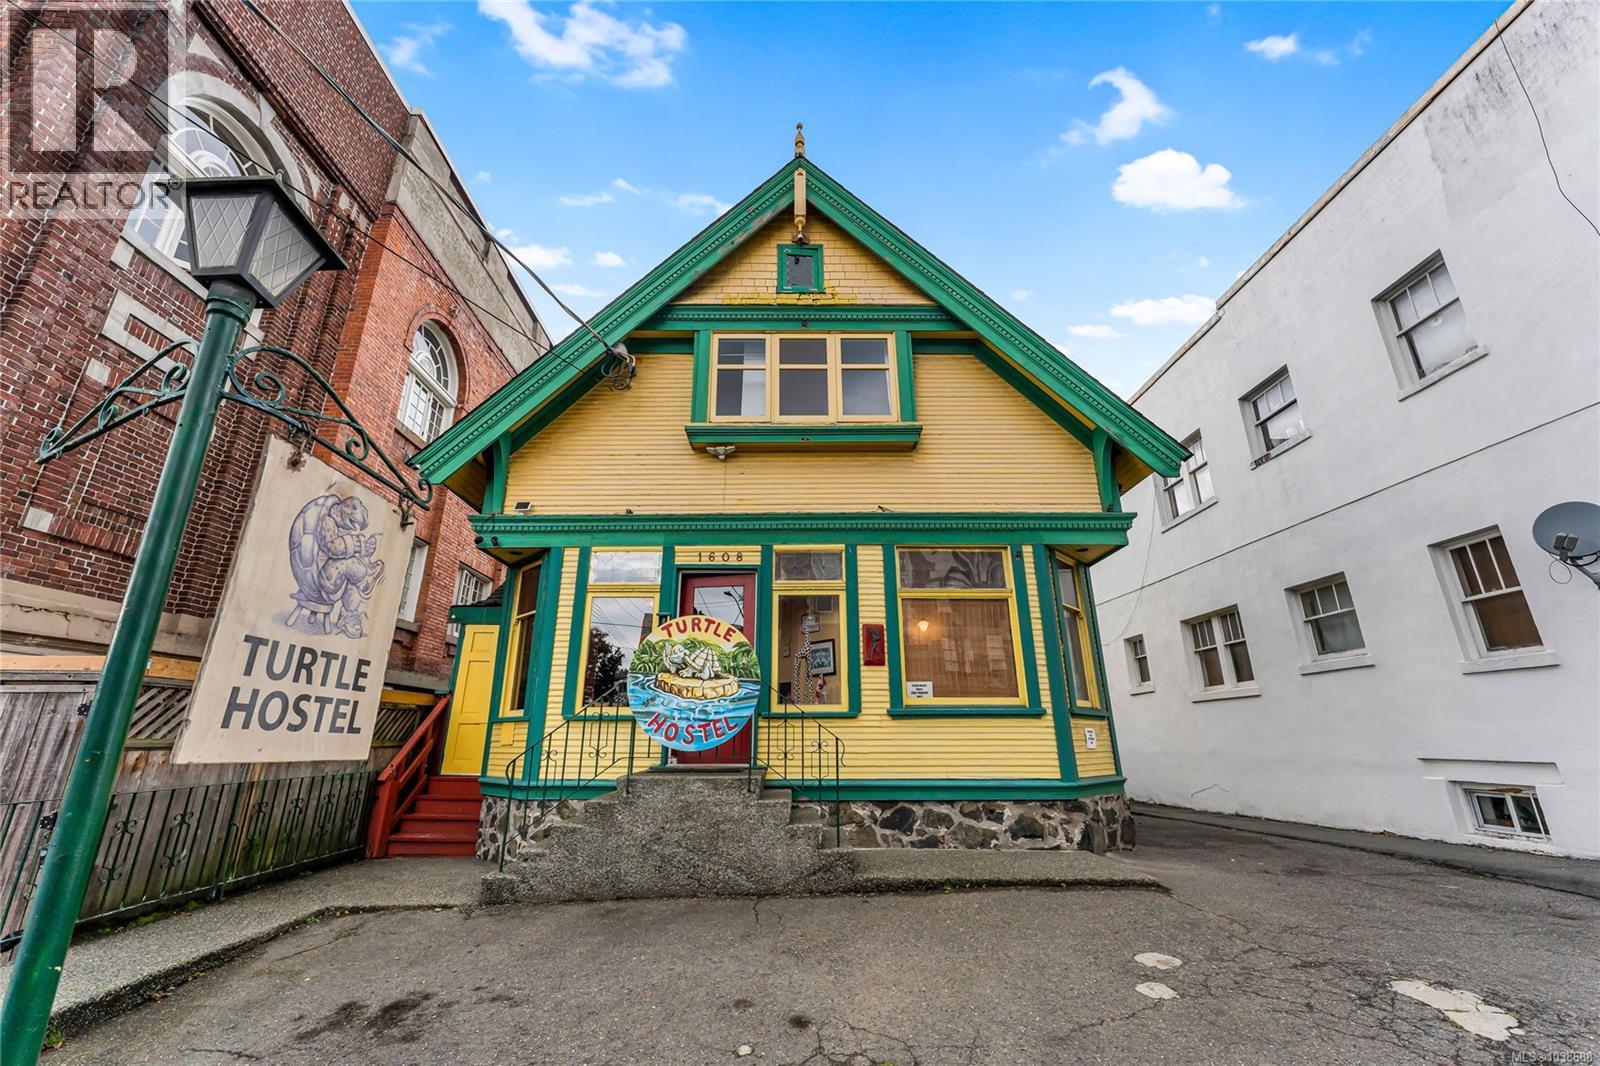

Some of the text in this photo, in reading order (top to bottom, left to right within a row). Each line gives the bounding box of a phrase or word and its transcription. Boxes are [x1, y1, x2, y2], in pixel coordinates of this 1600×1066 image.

[698, 551, 743, 562] 1608
[661, 617, 737, 643] TURTLE
[243, 634, 371, 692] TURTLE
[220, 686, 361, 734] HOSTEL
[647, 712, 739, 745] HOSTEL
